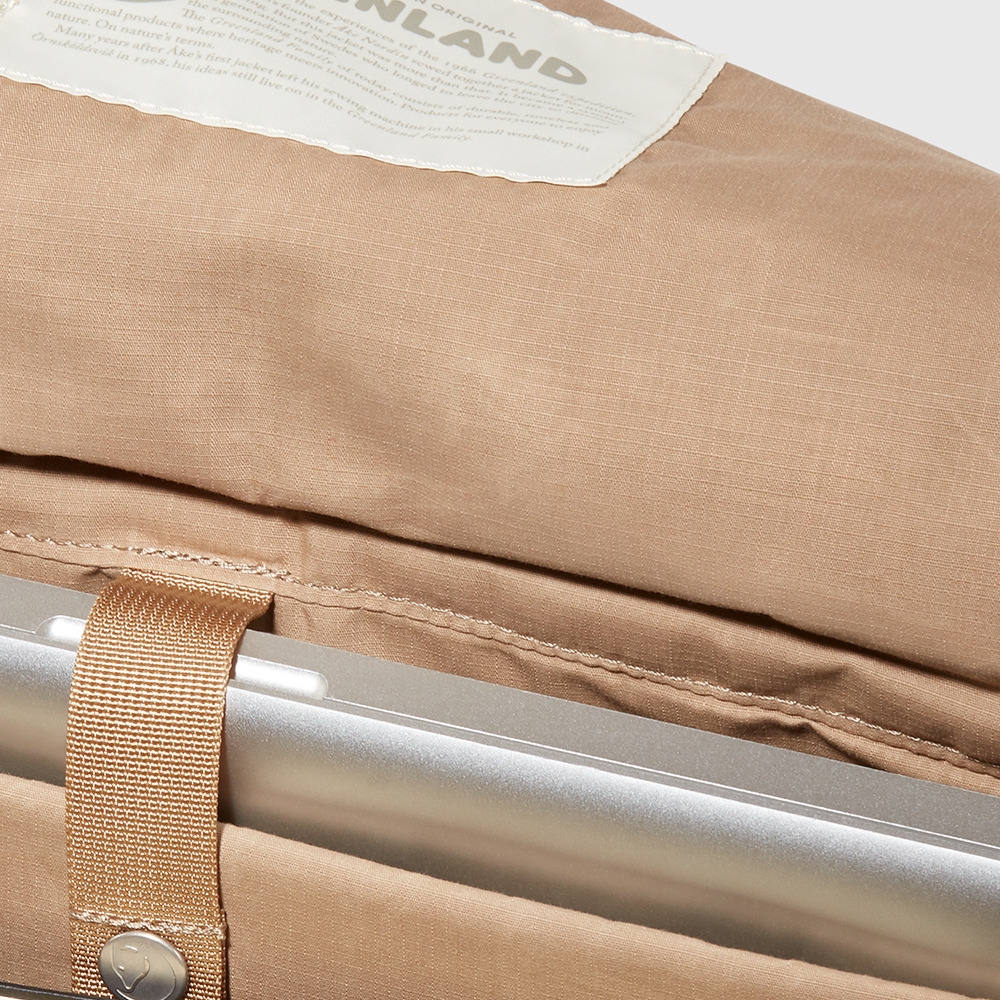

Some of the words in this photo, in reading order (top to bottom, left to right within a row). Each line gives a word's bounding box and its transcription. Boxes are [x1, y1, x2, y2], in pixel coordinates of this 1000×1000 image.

[46, 10, 91, 26] nature.
[95, 18, 117, 31] On
[175, 36, 215, 49] terms.
[181, 7, 206, 21] The
[210, 16, 284, 43] Greenland
[286, 42, 334, 66] Family
[337, 64, 356, 73] of
[355, 72, 391, 92] today
[392, 91, 444, 108] consists
[212, 6, 291, 39] surrounding
[294, 36, 337, 58] nature.
[273, 9, 297, 22] But
[300, 20, 323, 34] this
[325, 31, 365, 50] jacket
[367, 49, 391, 63] was
[393, 61, 427, 78] more
[430, 76, 460, 89] than
[281, 3, 331, 26] founder
[361, 36, 408, 60] Nordin
[411, 58, 451, 77] sewed
[453, 74, 509, 90] together
[320, 9, 394, 43] experiences
[399, 43, 417, 52] of
[418, 49, 438, 61] the
[445, 61, 476, 75] 1966
[334, 0, 587, 85] NLAND
[431, 3, 517, 39] ORIGINAL
[54, 24, 97, 41] Many
[94, 35, 130, 47] years
[132, 42, 164, 54] after
[205, 52, 231, 64] first
[230, 57, 273, 75] jacket
[276, 70, 299, 82] left
[300, 77, 321, 90] his
[322, 87, 366, 113] sewing
[369, 110, 426, 131] machine
[467, 128, 505, 136] small
[506, 131, 573, 149] workshop
[575, 143, 589, 152] in
[116, 50, 129, 60] in
[172, 60, 193, 71] his
[195, 64, 229, 76] ideas
[231, 70, 258, 82] still
[259, 76, 283, 90] live
[284, 87, 302, 96] on
[305, 90, 320, 101] in
[322, 98, 343, 111] the
[347, 110, 420, 138] Greenland
[122, 11, 183, 30] products
[186, 24, 226, 39] where
[228, 31, 283, 54] heritage
[284, 52, 323, 70] meets
[326, 67, 397, 106] innovation.
[400, 102, 460, 117] Products
[311, 33, 359, 58] Swedes
[361, 56, 389, 72] who
[391, 70, 437, 91] longed
[439, 89, 454, 97] to
